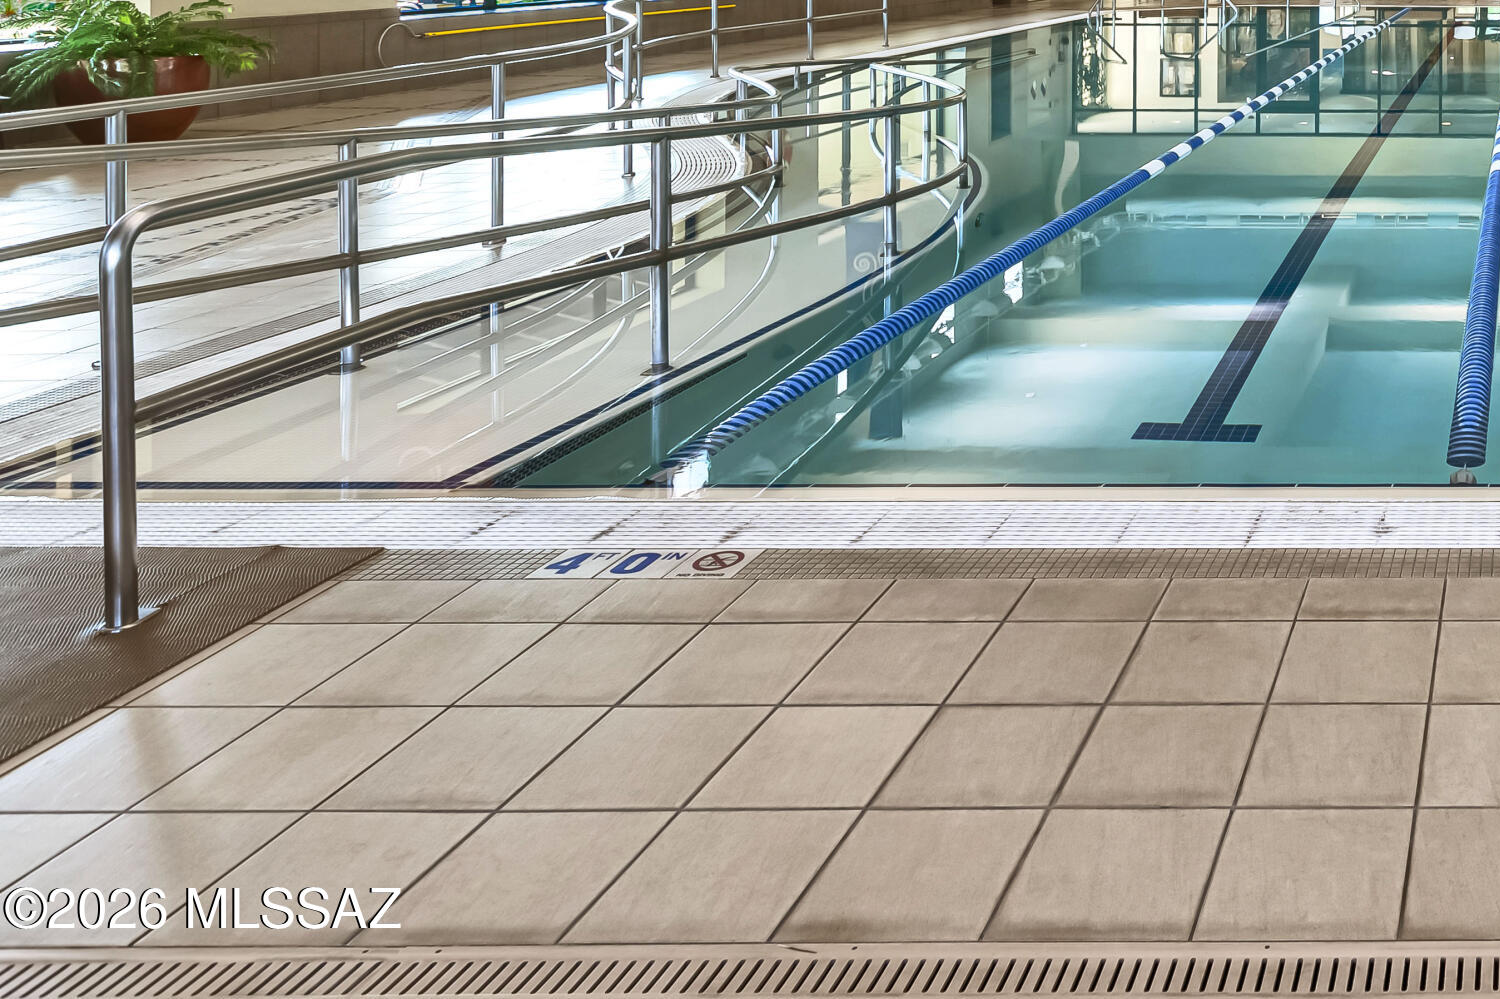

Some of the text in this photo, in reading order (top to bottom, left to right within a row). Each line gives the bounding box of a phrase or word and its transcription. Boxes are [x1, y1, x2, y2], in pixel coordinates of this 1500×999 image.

[544, 552, 595, 574] 4
[593, 552, 621, 560] FT
[661, 552, 688, 560] IN
